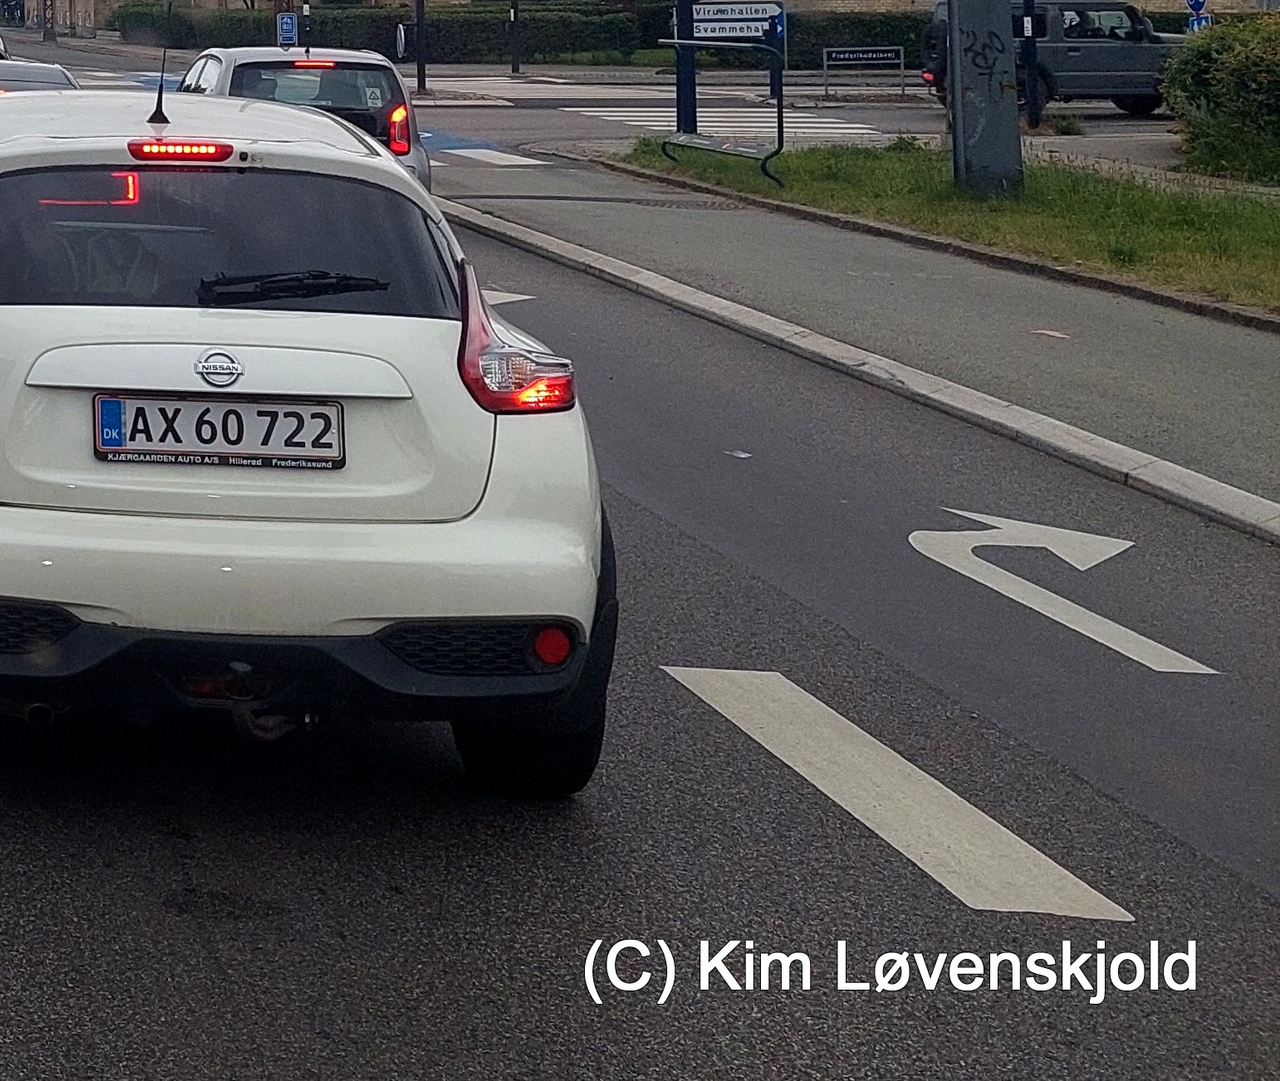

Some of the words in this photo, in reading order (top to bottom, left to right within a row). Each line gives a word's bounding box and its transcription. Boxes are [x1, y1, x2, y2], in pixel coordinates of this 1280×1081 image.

[694, 6, 768, 16] Virumhallen
[201, 364, 239, 372] NISSAN
[103, 428, 120, 440] DK
[128, 406, 183, 444] AX
[195, 407, 244, 446] 60
[256, 410, 334, 449] 722
[177, 455, 202, 464] AUTO
[203, 456, 220, 465] A/S
